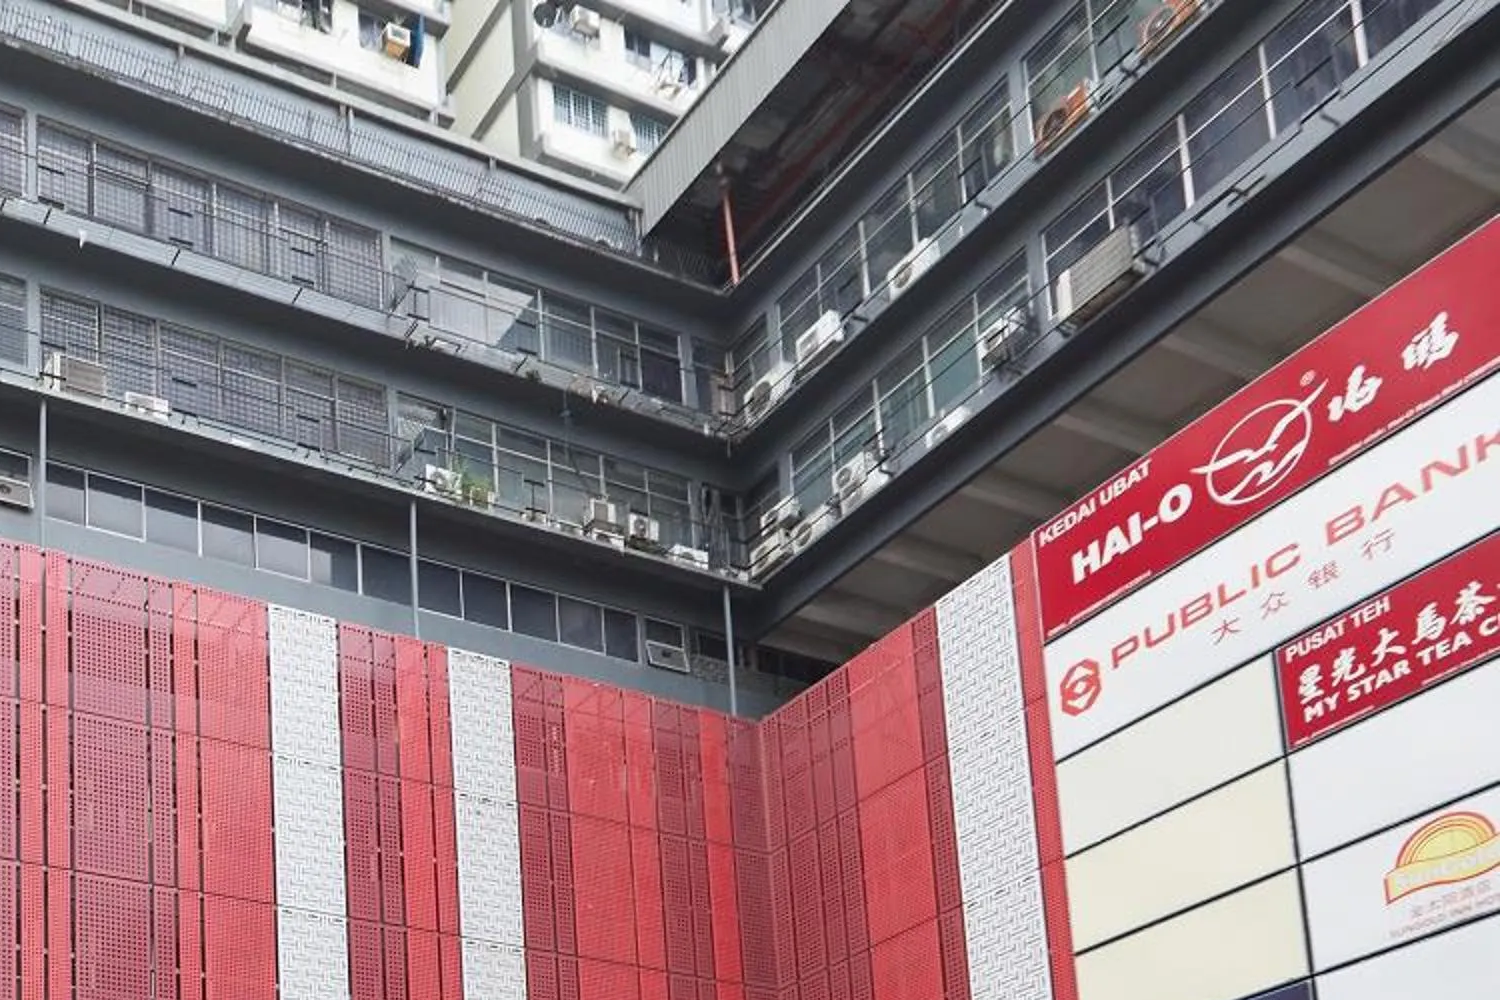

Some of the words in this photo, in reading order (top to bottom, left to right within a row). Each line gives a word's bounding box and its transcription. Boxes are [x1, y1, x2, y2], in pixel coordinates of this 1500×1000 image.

[1039, 498, 1096, 547] KEDAI
[1100, 458, 1152, 507] UBAT
[1071, 483, 1193, 584] HAI-O
[1110, 542, 1301, 670] PUBLIC
[1285, 618, 1348, 663] PUSAT
[1350, 596, 1391, 628] TEH
[1297, 581, 1500, 704] 星光大馬茶
[1304, 692, 1340, 723] MY
[1348, 660, 1411, 702] STAR
[1416, 631, 1473, 666] TEA
[1479, 612, 1500, 636] C
